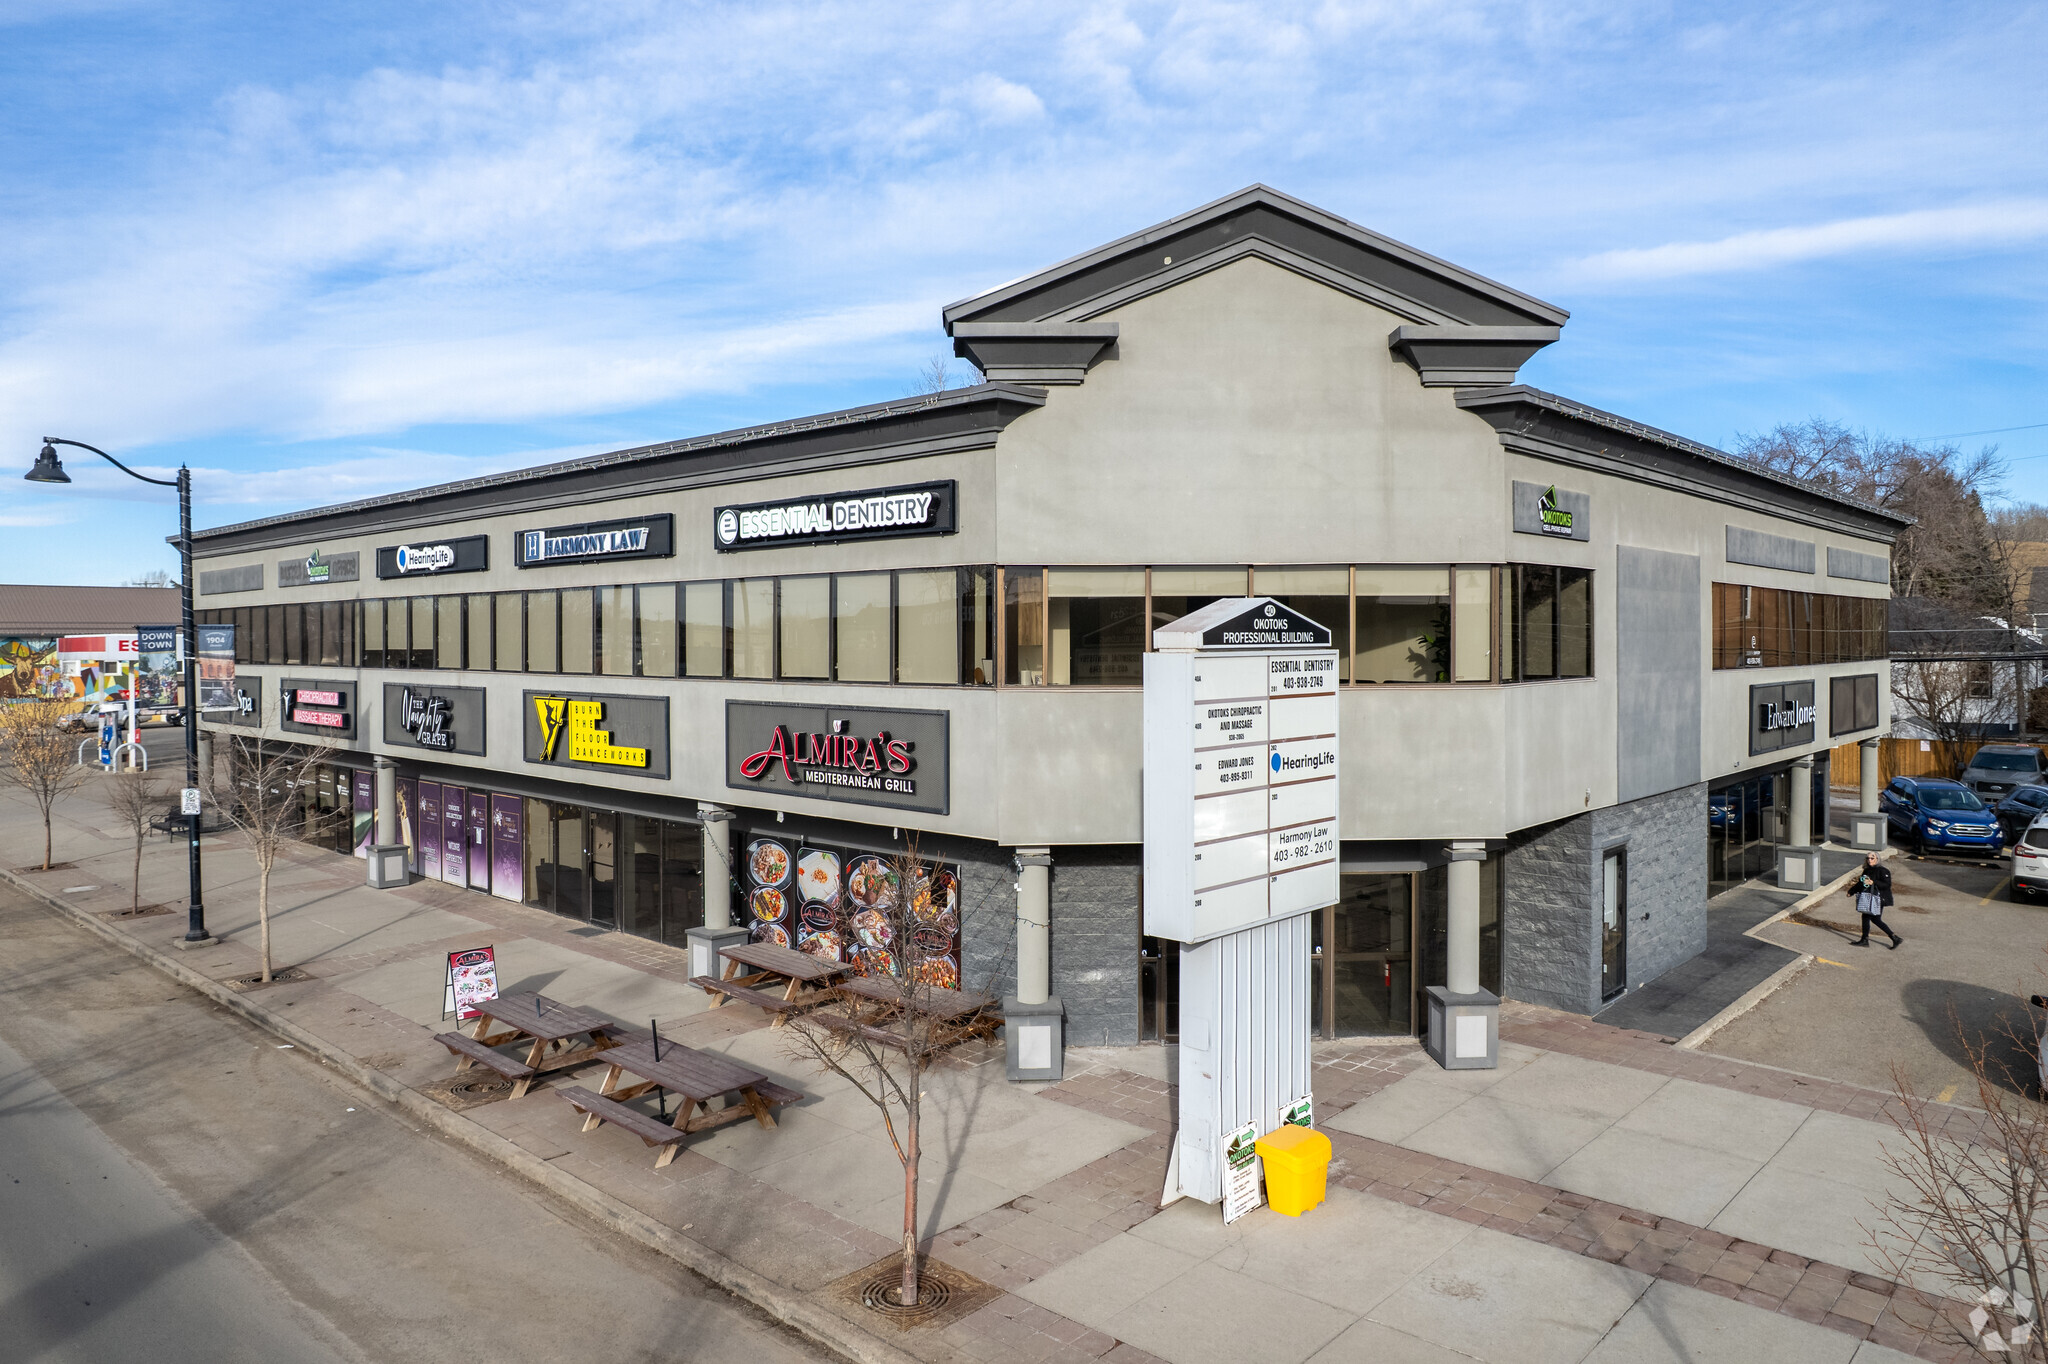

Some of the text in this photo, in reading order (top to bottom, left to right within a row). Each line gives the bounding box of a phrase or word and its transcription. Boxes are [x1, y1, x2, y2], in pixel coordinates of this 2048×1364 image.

[742, 496, 928, 535] ESSENTIAL DENTISTRY
[1543, 510, 1572, 527] OKOTOKS
[544, 532, 607, 557] HARMONY
[611, 529, 643, 551] LAW
[409, 550, 448, 566] HearingLife
[1266, 605, 1275, 616] 40
[1254, 618, 1288, 630] OKOTOKS
[141, 632, 173, 641] DOWN
[206, 636, 226, 645] 1904
[1223, 631, 1314, 644] PROFESSIONAL BUILDING
[118, 639, 139, 652] ES
[143, 641, 173, 650] TOWN
[1271, 659, 1334, 673] ESSENTIAL DENTISTRY
[1283, 675, 1324, 689] 403-938-2749
[237, 688, 253, 716] Spa
[413, 700, 424, 709] THE
[402, 690, 444, 741] Naughty
[575, 705, 600, 715] BURN
[1207, 705, 1262, 719] OKOTOKS CHIROPRACTIC
[1767, 700, 1816, 730] Edward Jones
[295, 710, 342, 725] MASSAGE THERAPY
[575, 719, 593, 729] THE
[1220, 719, 1253, 731] AND MASSAGE
[421, 731, 447, 747] GRAPE
[575, 732, 608, 744] FLOOR
[575, 747, 644, 763] DANCEWORKS
[739, 725, 910, 783] ALMIRA'S
[1282, 752, 1335, 770] HearingLife
[1218, 756, 1254, 770] EDWARD JONES
[805, 770, 913, 793] MEDITERRANEAN GRILL
[1279, 827, 1328, 844] Harmony Law
[1273, 850, 1289, 862] 403
[1294, 846, 1309, 858] 982
[1314, 840, 1333, 854] 2610
